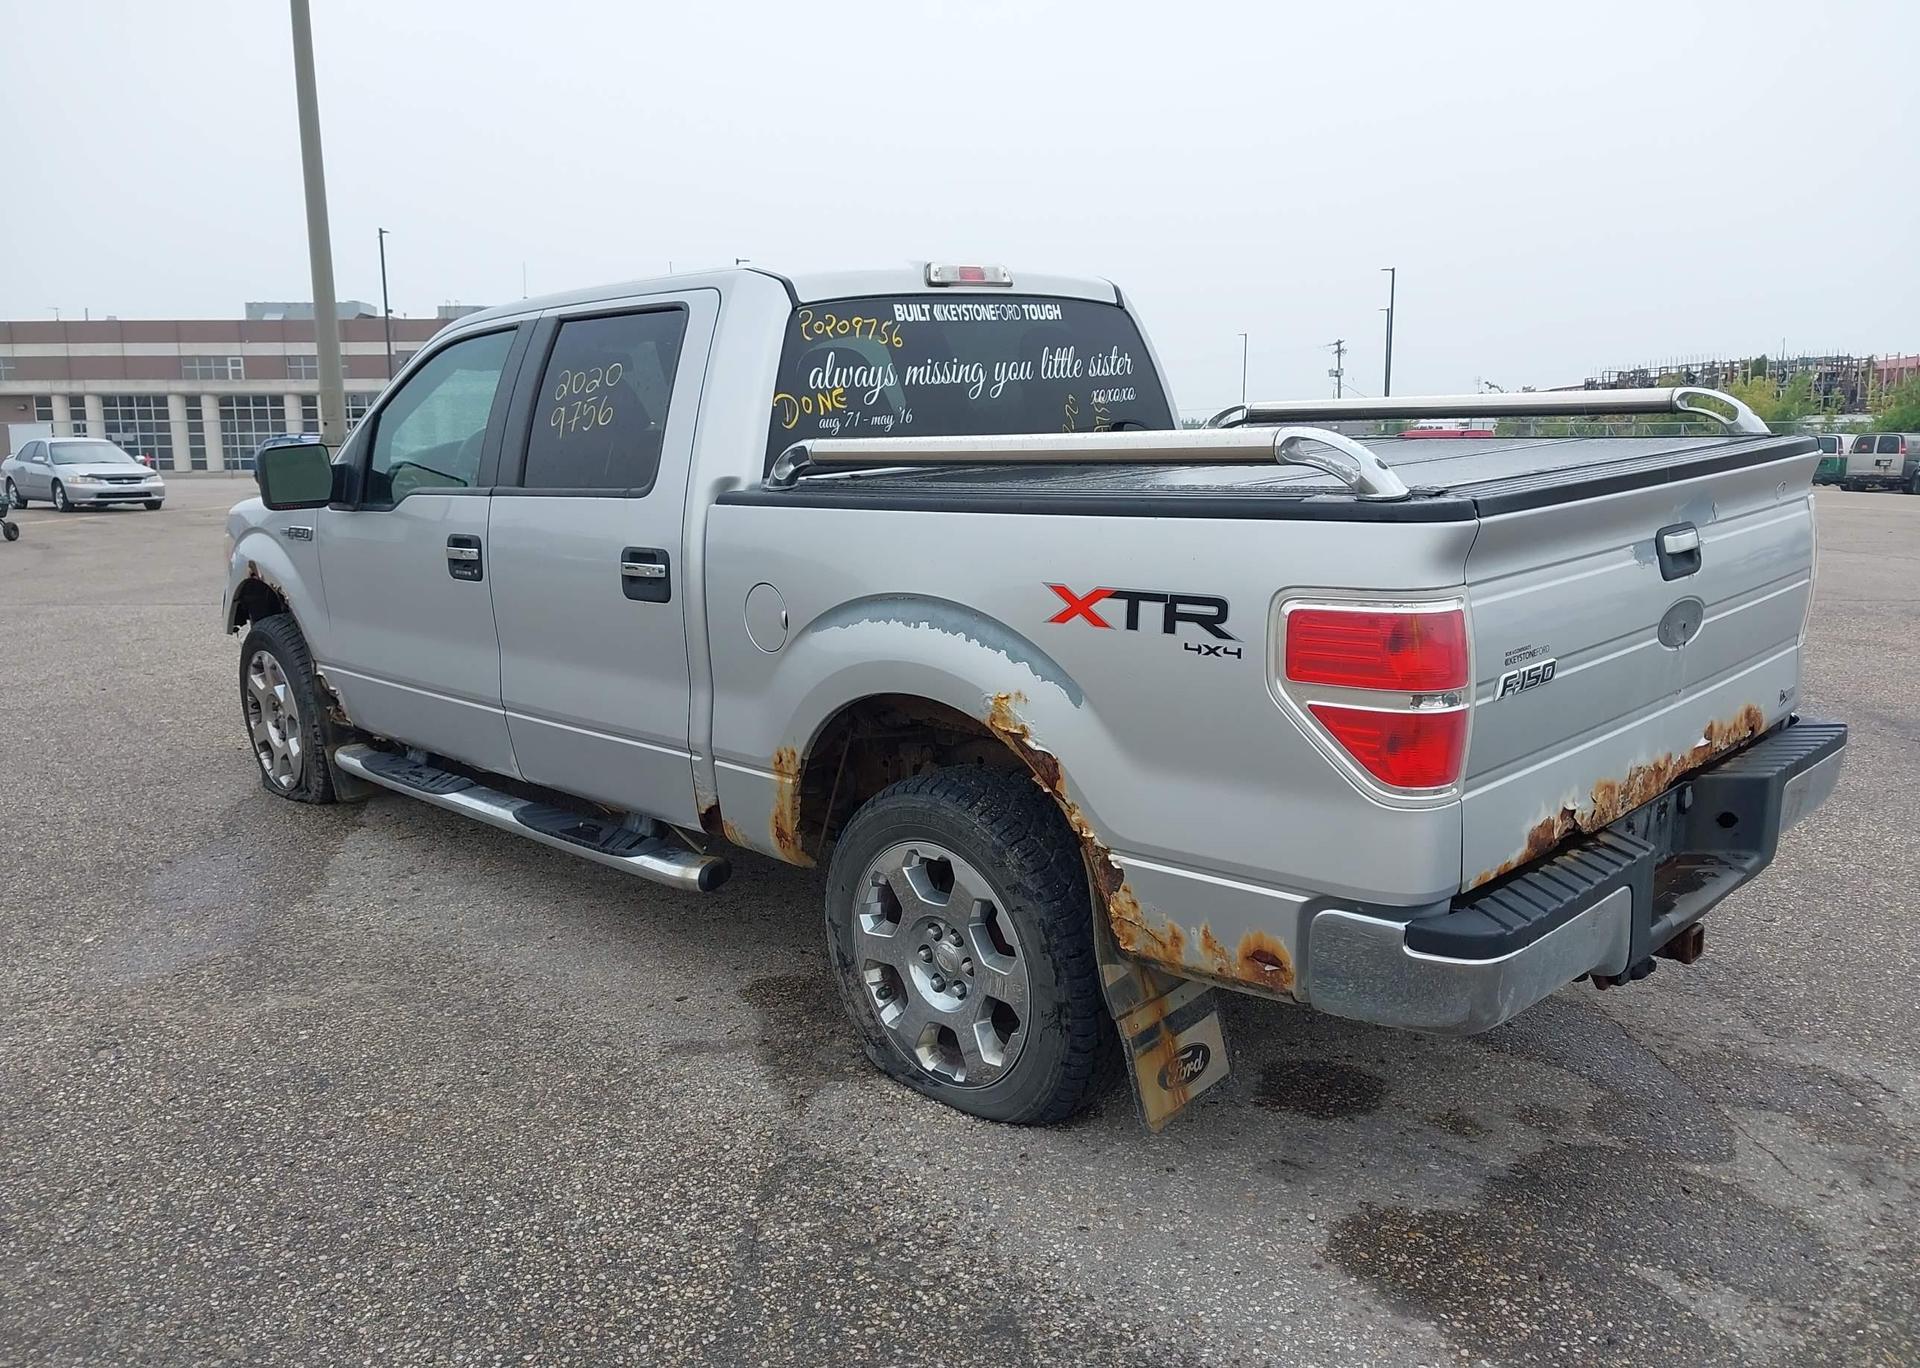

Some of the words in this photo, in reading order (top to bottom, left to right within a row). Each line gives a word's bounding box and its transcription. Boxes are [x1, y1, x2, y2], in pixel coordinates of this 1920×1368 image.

[798, 309, 903, 348] 20209756
[893, 303, 930, 321] BUILT
[940, 303, 1022, 321] KEYSTONEFORD
[1022, 303, 1063, 321] TOUGH
[555, 362, 623, 401] 2020
[809, 351, 898, 406] always
[905, 357, 987, 400] missing
[989, 360, 1034, 399] you
[1040, 345, 1083, 380] little
[1088, 345, 1134, 377] sister
[773, 387, 848, 430] DONE
[1090, 386, 1137, 405] xoxoxo
[550, 394, 614, 439] 9756
[818, 416, 841, 436] aug
[870, 412, 895, 433] may
[1041, 581, 1245, 643] XTR
